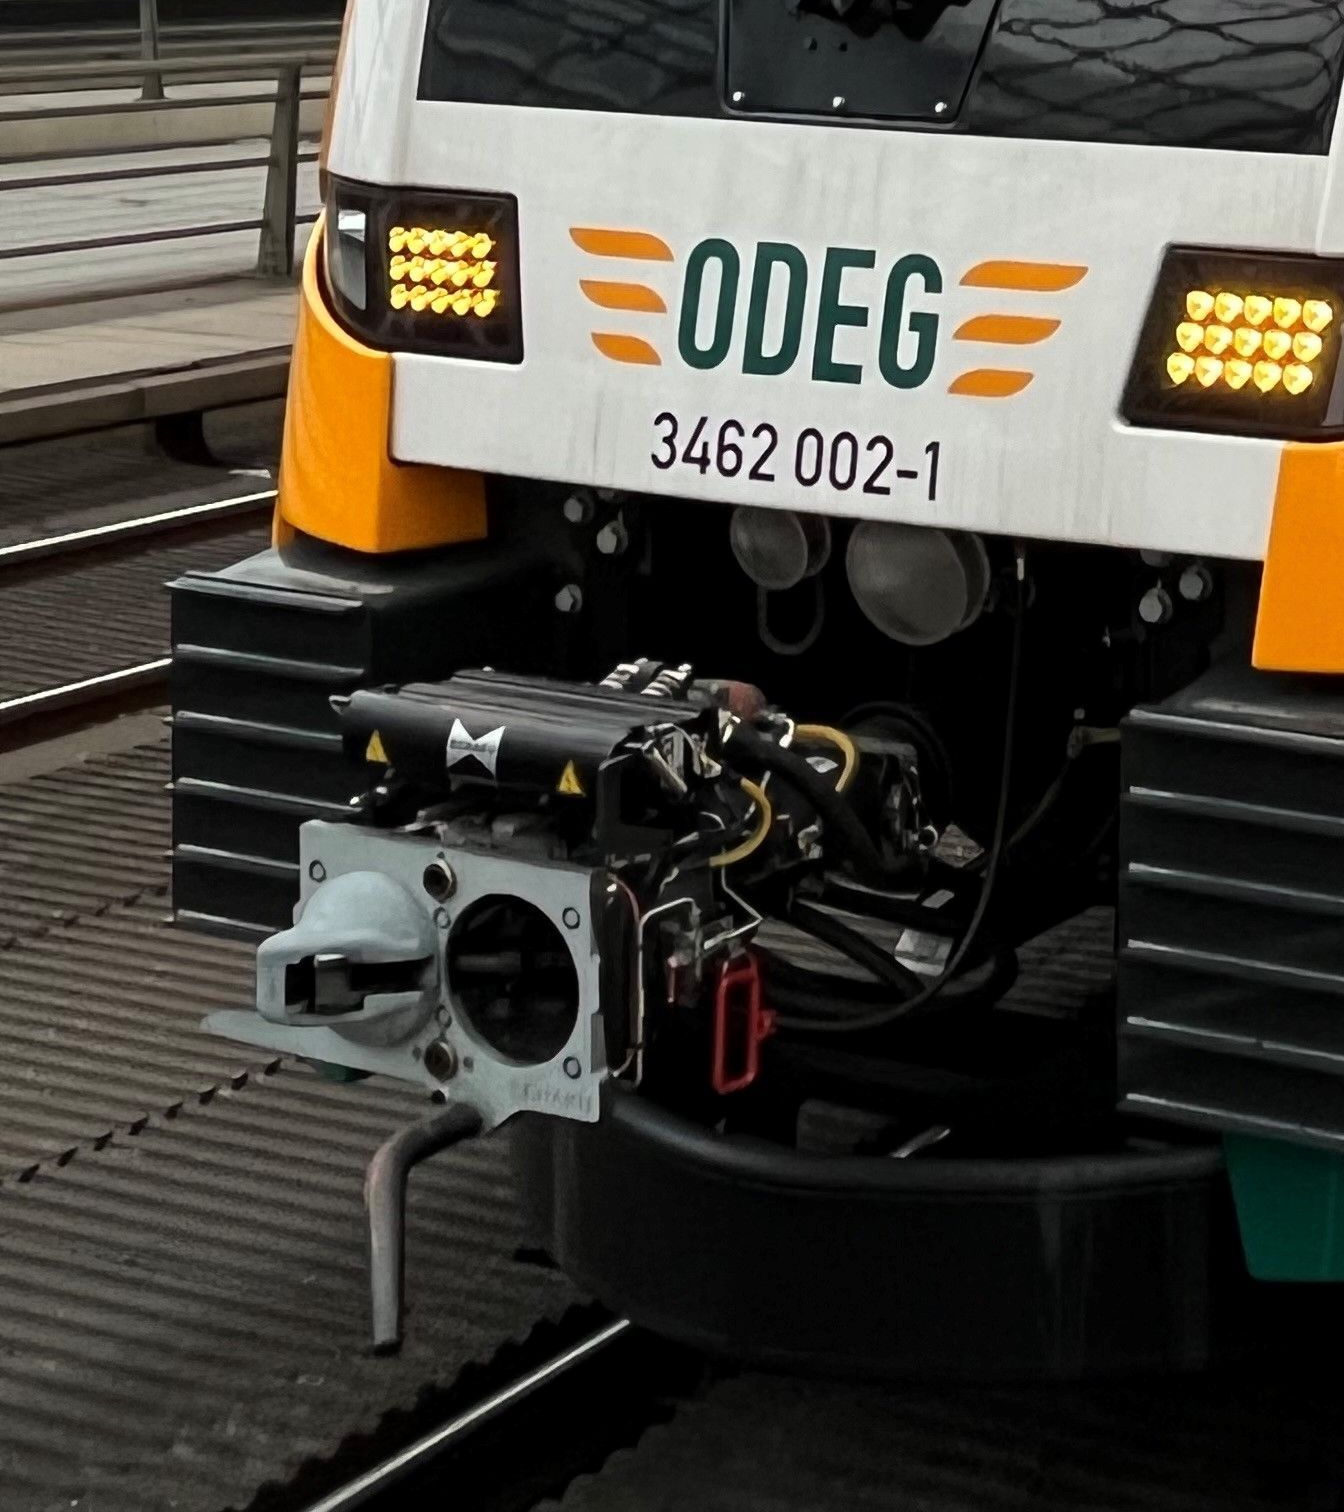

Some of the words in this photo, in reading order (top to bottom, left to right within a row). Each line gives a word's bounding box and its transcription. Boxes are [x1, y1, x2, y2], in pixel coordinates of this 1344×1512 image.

[677, 237, 944, 390] ODEG
[650, 412, 779, 483] 3462
[794, 427, 941, 501] 002-1
